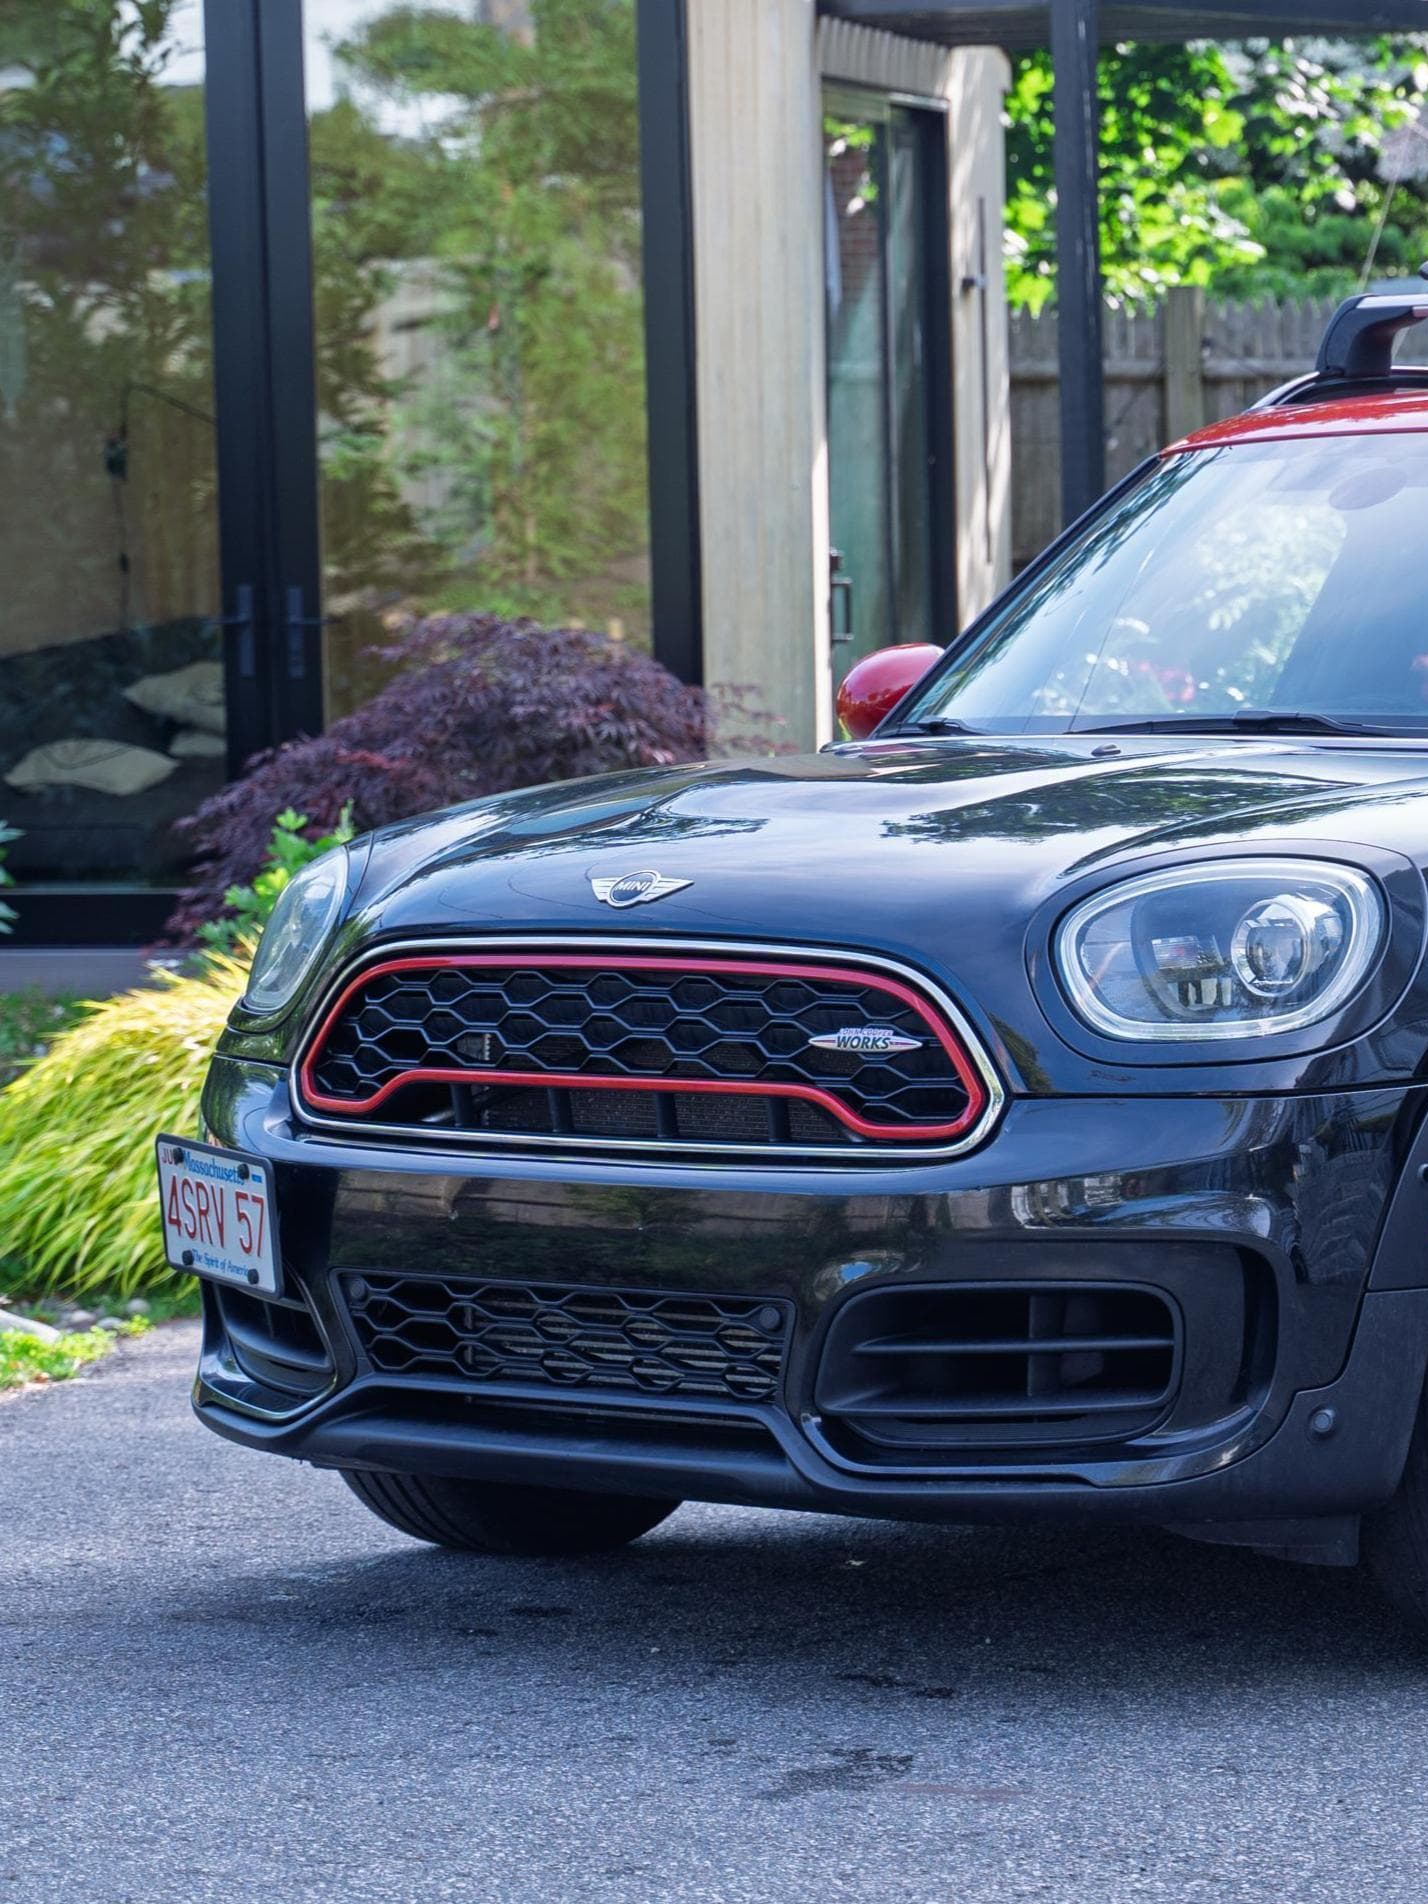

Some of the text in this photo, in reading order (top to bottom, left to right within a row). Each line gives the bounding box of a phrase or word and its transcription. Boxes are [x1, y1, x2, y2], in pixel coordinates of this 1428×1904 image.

[615, 880, 651, 891] MINI
[836, 1035, 891, 1049] WORKS
[168, 1175, 265, 1258] 4SRV 57
